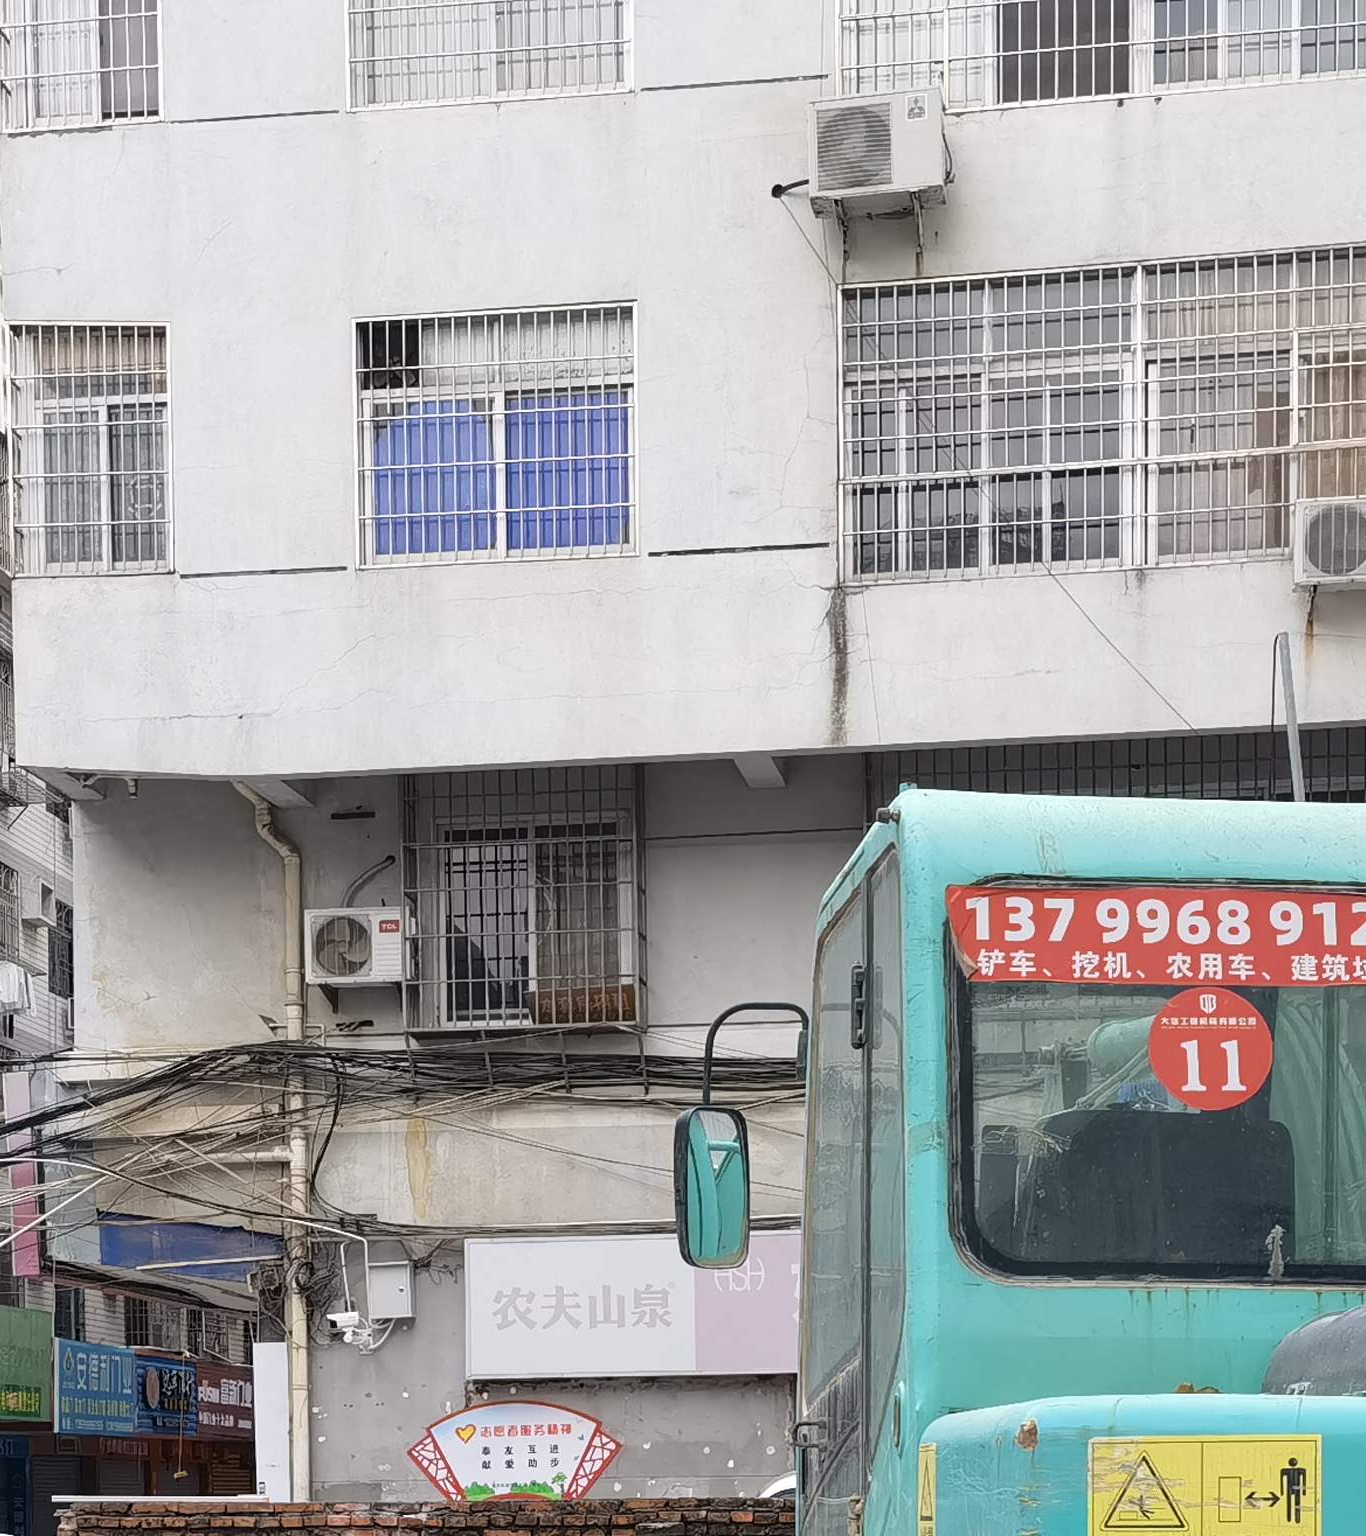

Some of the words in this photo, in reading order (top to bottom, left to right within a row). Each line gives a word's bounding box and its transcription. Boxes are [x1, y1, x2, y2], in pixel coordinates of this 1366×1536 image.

[965, 897, 1075, 944] 137
[1096, 898, 1251, 945] 9968
[1180, 1039, 1248, 1093] 11
[491, 1283, 673, 1330] 农夫山泉
